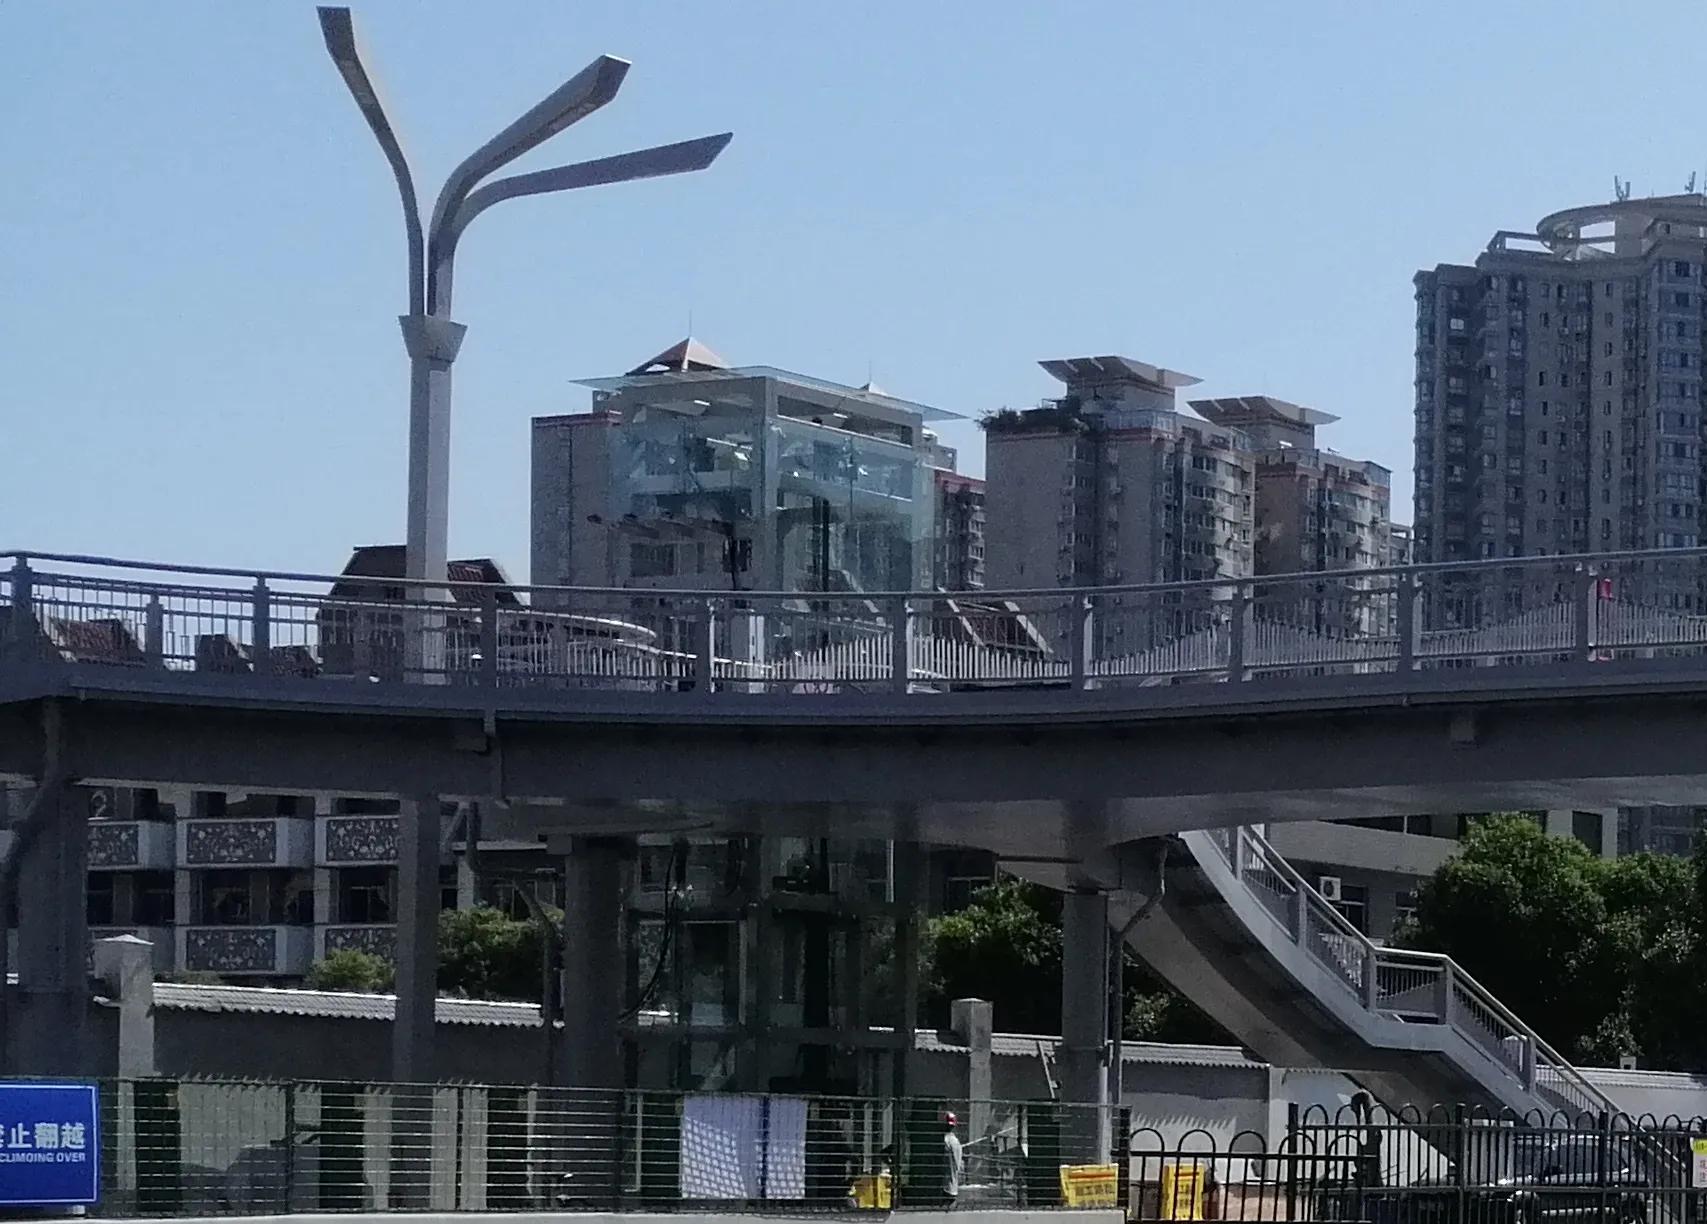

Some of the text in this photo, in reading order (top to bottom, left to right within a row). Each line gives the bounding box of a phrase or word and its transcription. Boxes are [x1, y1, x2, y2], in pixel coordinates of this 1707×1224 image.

[0, 1122, 86, 1150] 止翻越
[56, 1152, 86, 1163] OVER
